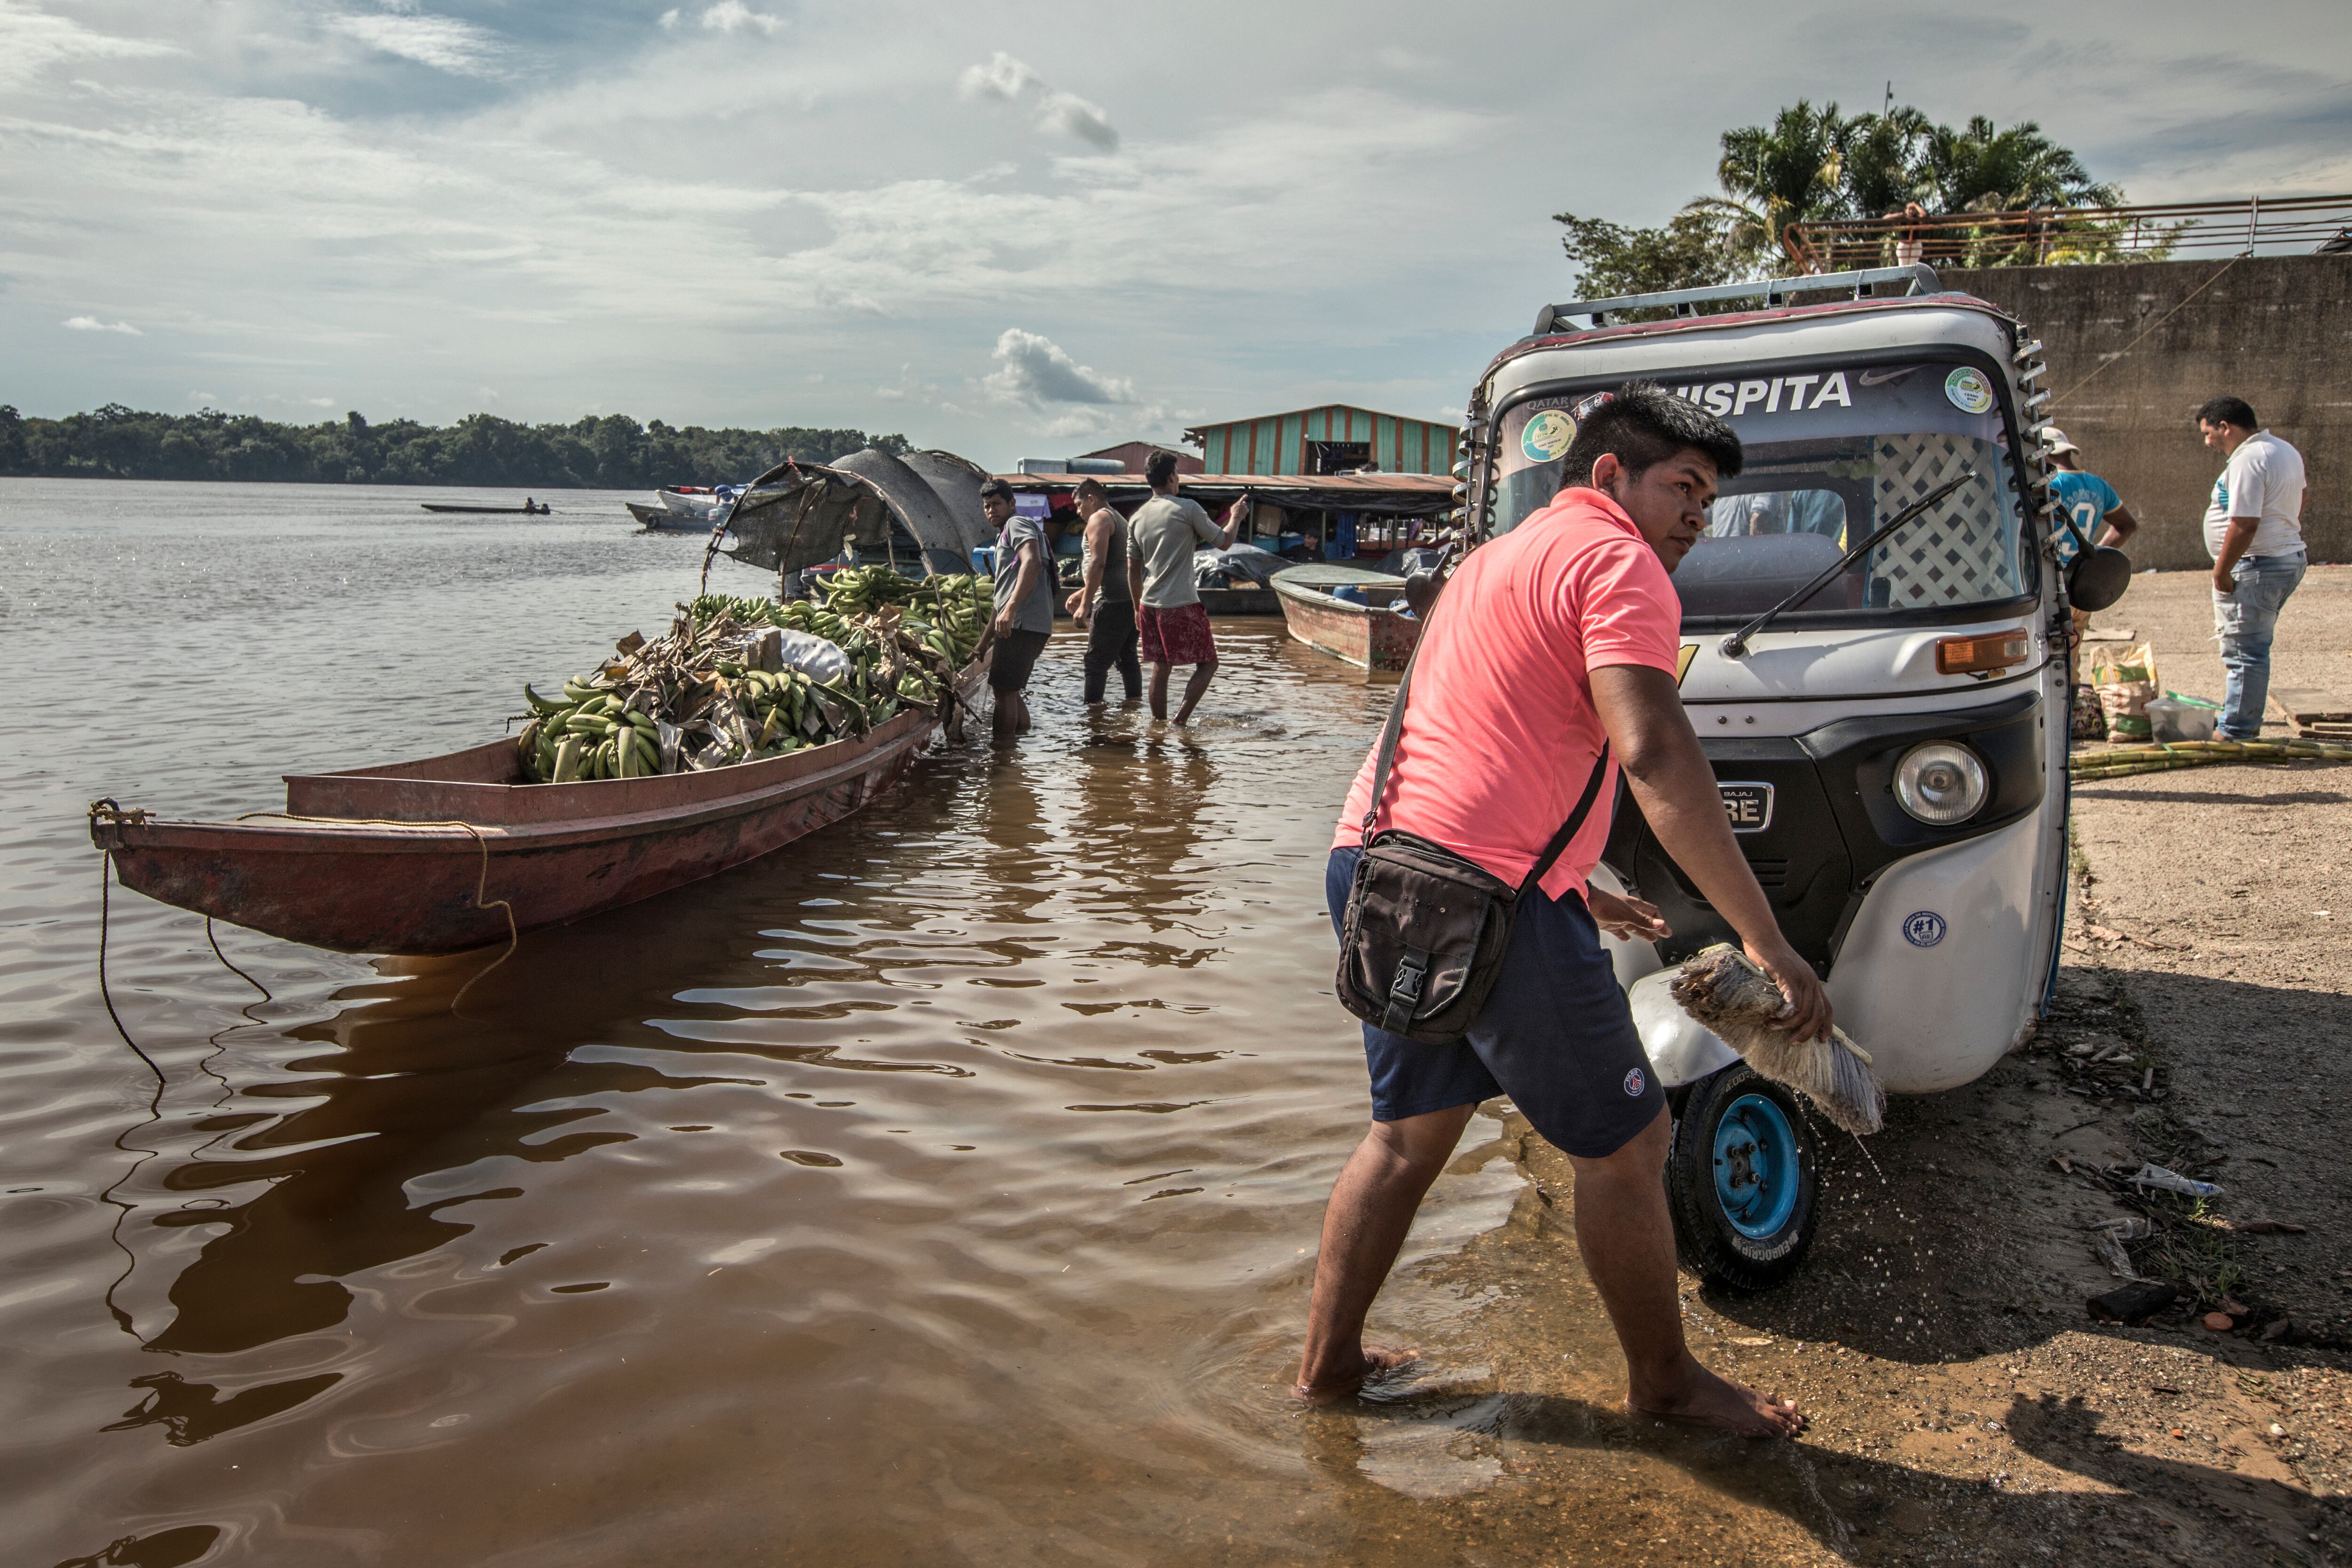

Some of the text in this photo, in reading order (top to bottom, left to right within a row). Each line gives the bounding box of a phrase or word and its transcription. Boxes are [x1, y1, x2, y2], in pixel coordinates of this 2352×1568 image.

[1527, 396, 1569, 410] QATAR
[1655, 371, 1852, 417] ISPITA
[1723, 800, 1760, 822] RE
[1913, 918, 1934, 934] #1
[1626, 1069, 1638, 1082] PARIS
[1741, 1240, 1791, 1261] EUROGRIP
